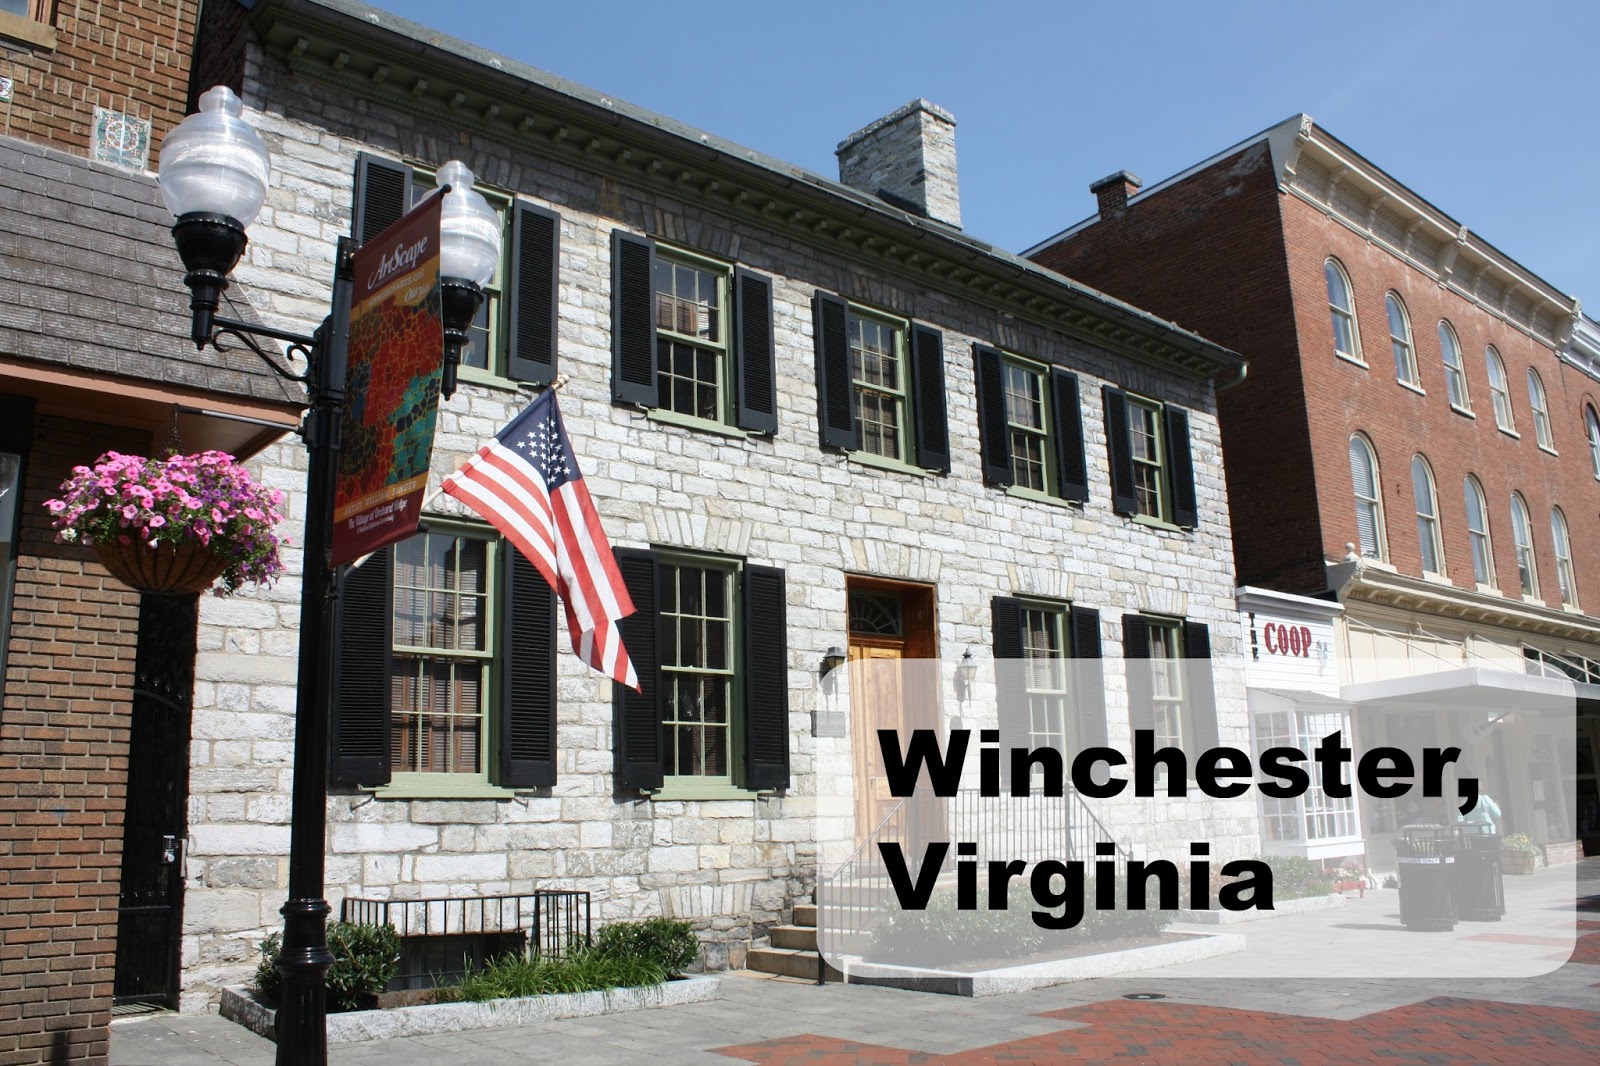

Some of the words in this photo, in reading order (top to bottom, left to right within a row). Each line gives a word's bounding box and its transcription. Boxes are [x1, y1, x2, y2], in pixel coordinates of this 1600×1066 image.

[367, 236, 428, 290] ArtScape
[391, 480, 417, 496] SINGER
[1264, 622, 1312, 658] COOP
